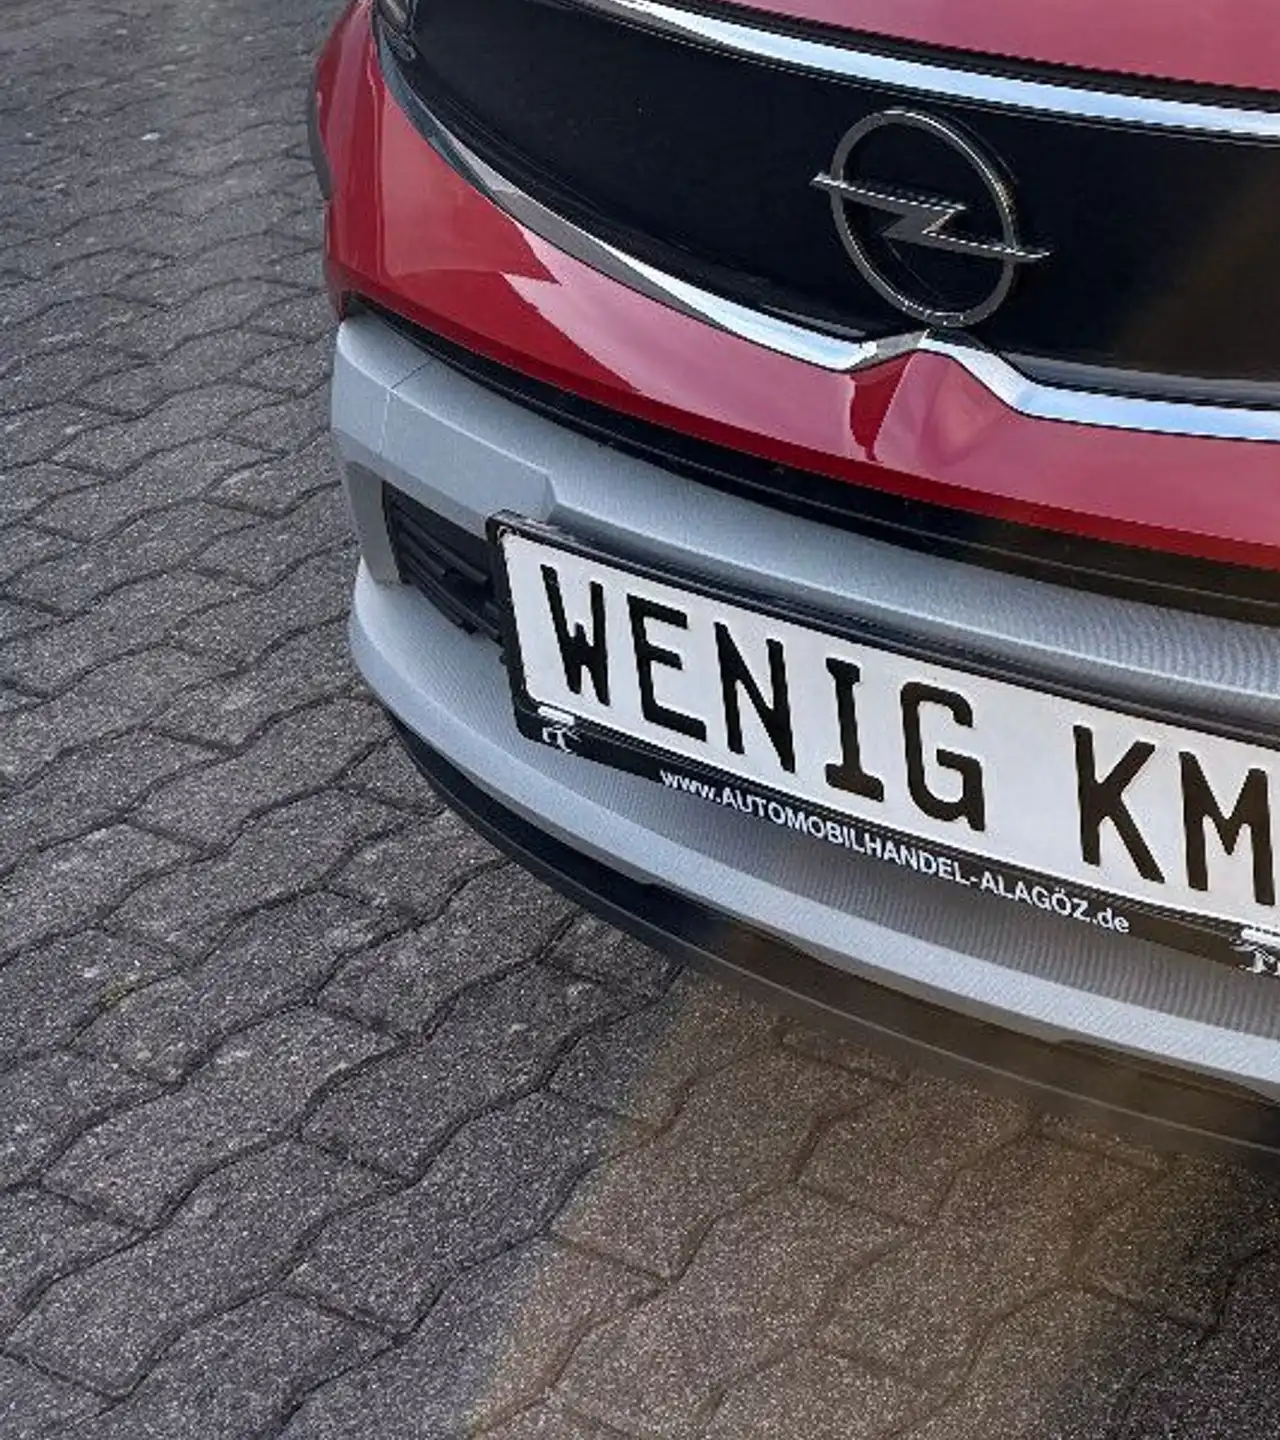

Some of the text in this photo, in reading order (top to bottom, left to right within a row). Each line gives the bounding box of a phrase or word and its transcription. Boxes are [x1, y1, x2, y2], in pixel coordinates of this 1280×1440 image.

[540, 562, 1276, 907] WENIG KM
[659, 769, 1131, 935] www.AUTOMOBILHANDEL-ALAGÖZ.de
